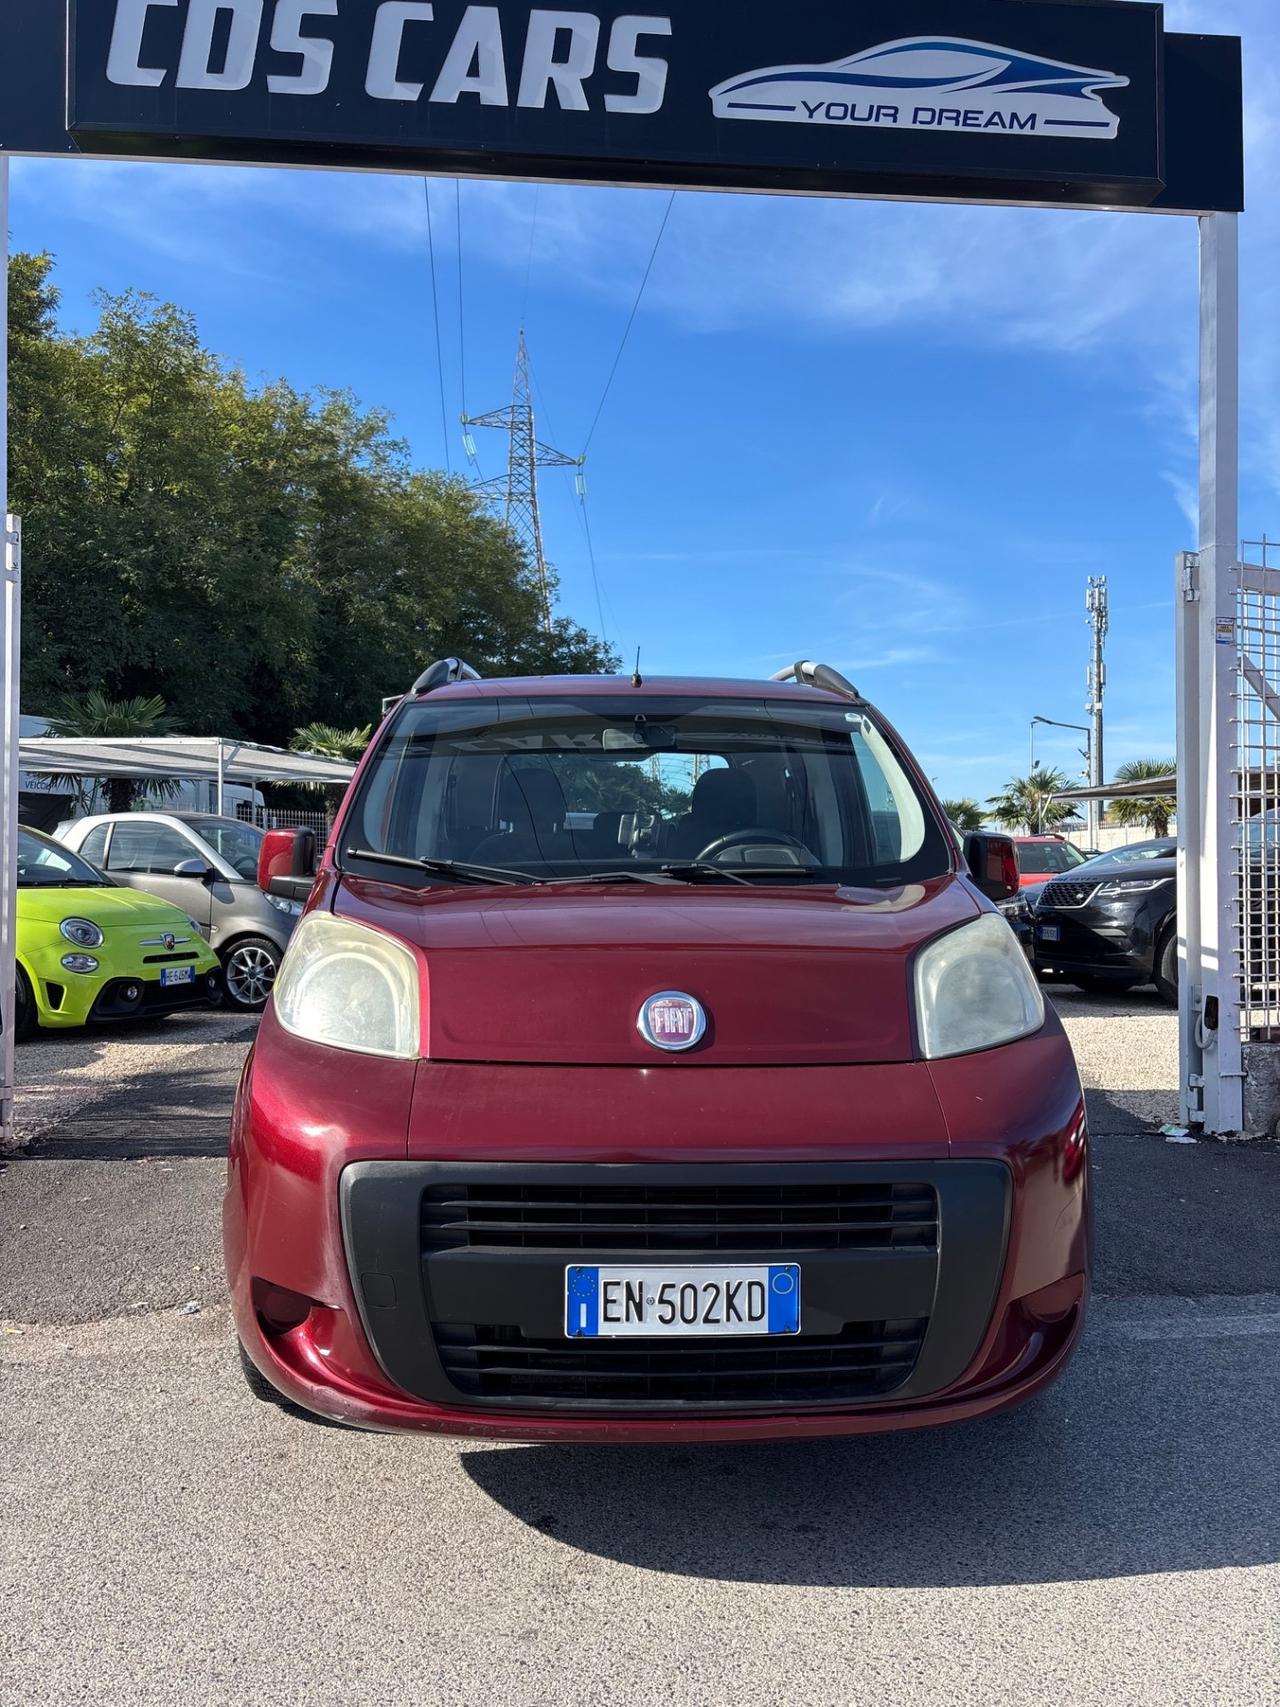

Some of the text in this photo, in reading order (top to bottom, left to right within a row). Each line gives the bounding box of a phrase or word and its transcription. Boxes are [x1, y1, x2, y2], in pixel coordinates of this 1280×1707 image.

[106, 0, 672, 114] CDS CARS
[801, 100, 1038, 131] YOUR DREAM
[654, 1007, 692, 1033] FIAT
